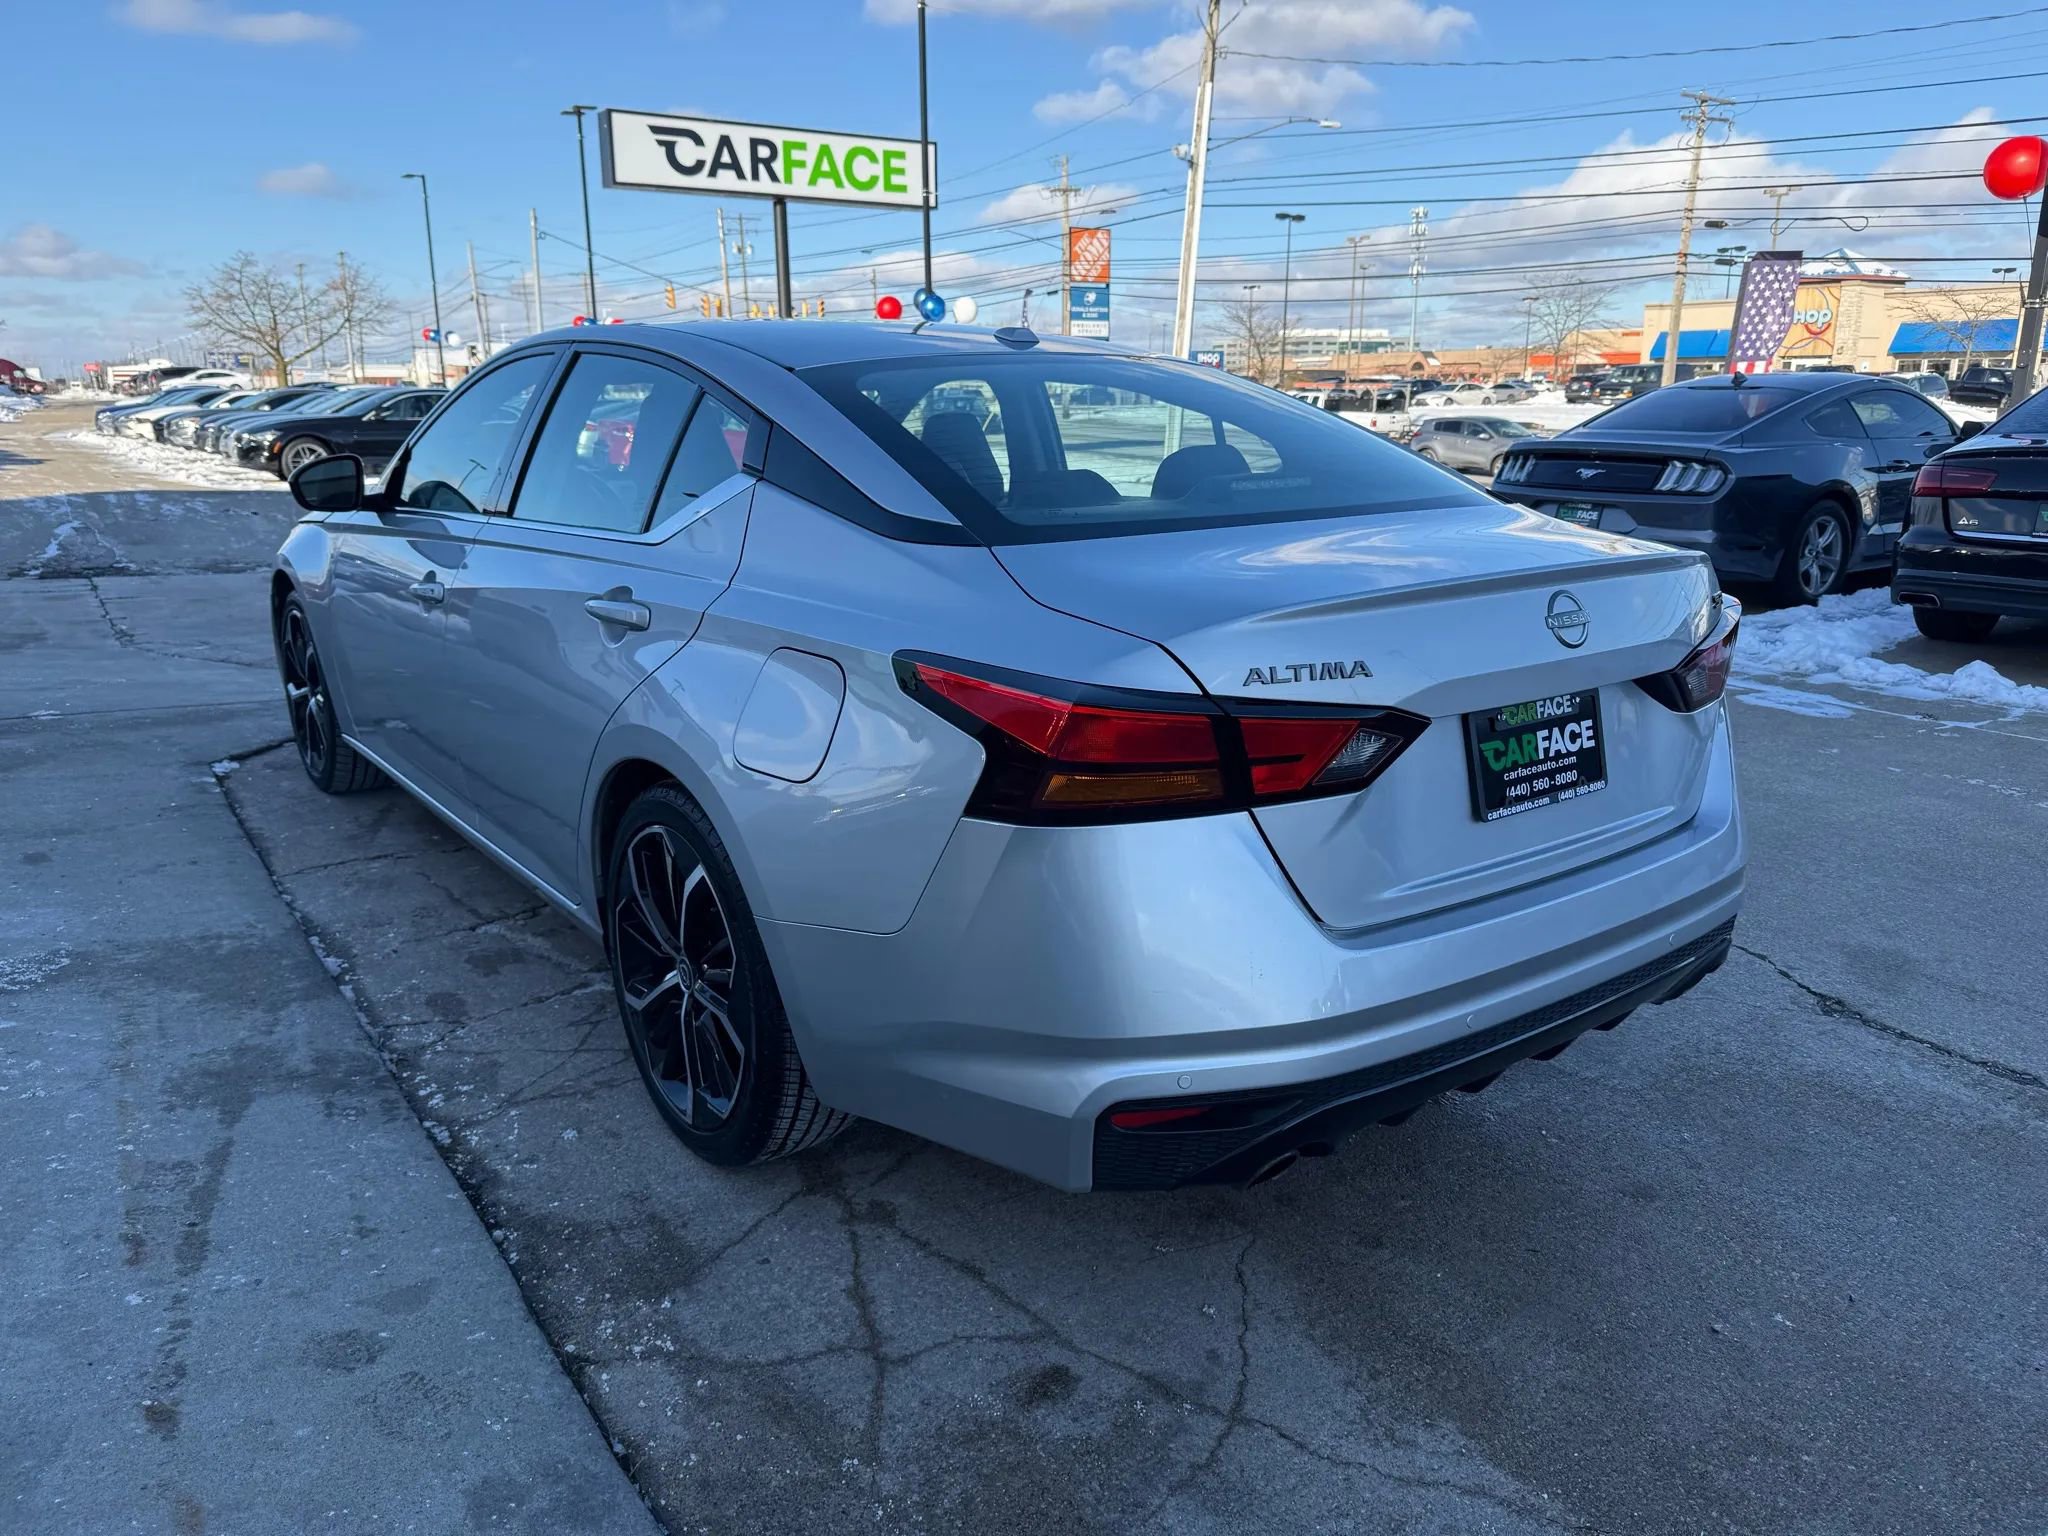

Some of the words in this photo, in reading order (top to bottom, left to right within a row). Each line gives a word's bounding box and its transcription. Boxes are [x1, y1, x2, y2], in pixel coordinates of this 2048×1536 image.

[647, 124, 908, 193] CARFACE
[1957, 516, 1979, 525] A6
[1548, 611, 1591, 627] NISSAN
[1242, 660, 1374, 687] ALTIMA
[1502, 694, 1572, 725] CARFACE
[1479, 719, 1596, 772] CARFACE
[1503, 755, 1577, 781] carfaceauto.com
[1487, 796, 1550, 820] carfaceauto.com
[1557, 788, 1576, 802] (440)
[1576, 780, 1606, 796] 560-8080
[1506, 783, 1531, 798] (440)
